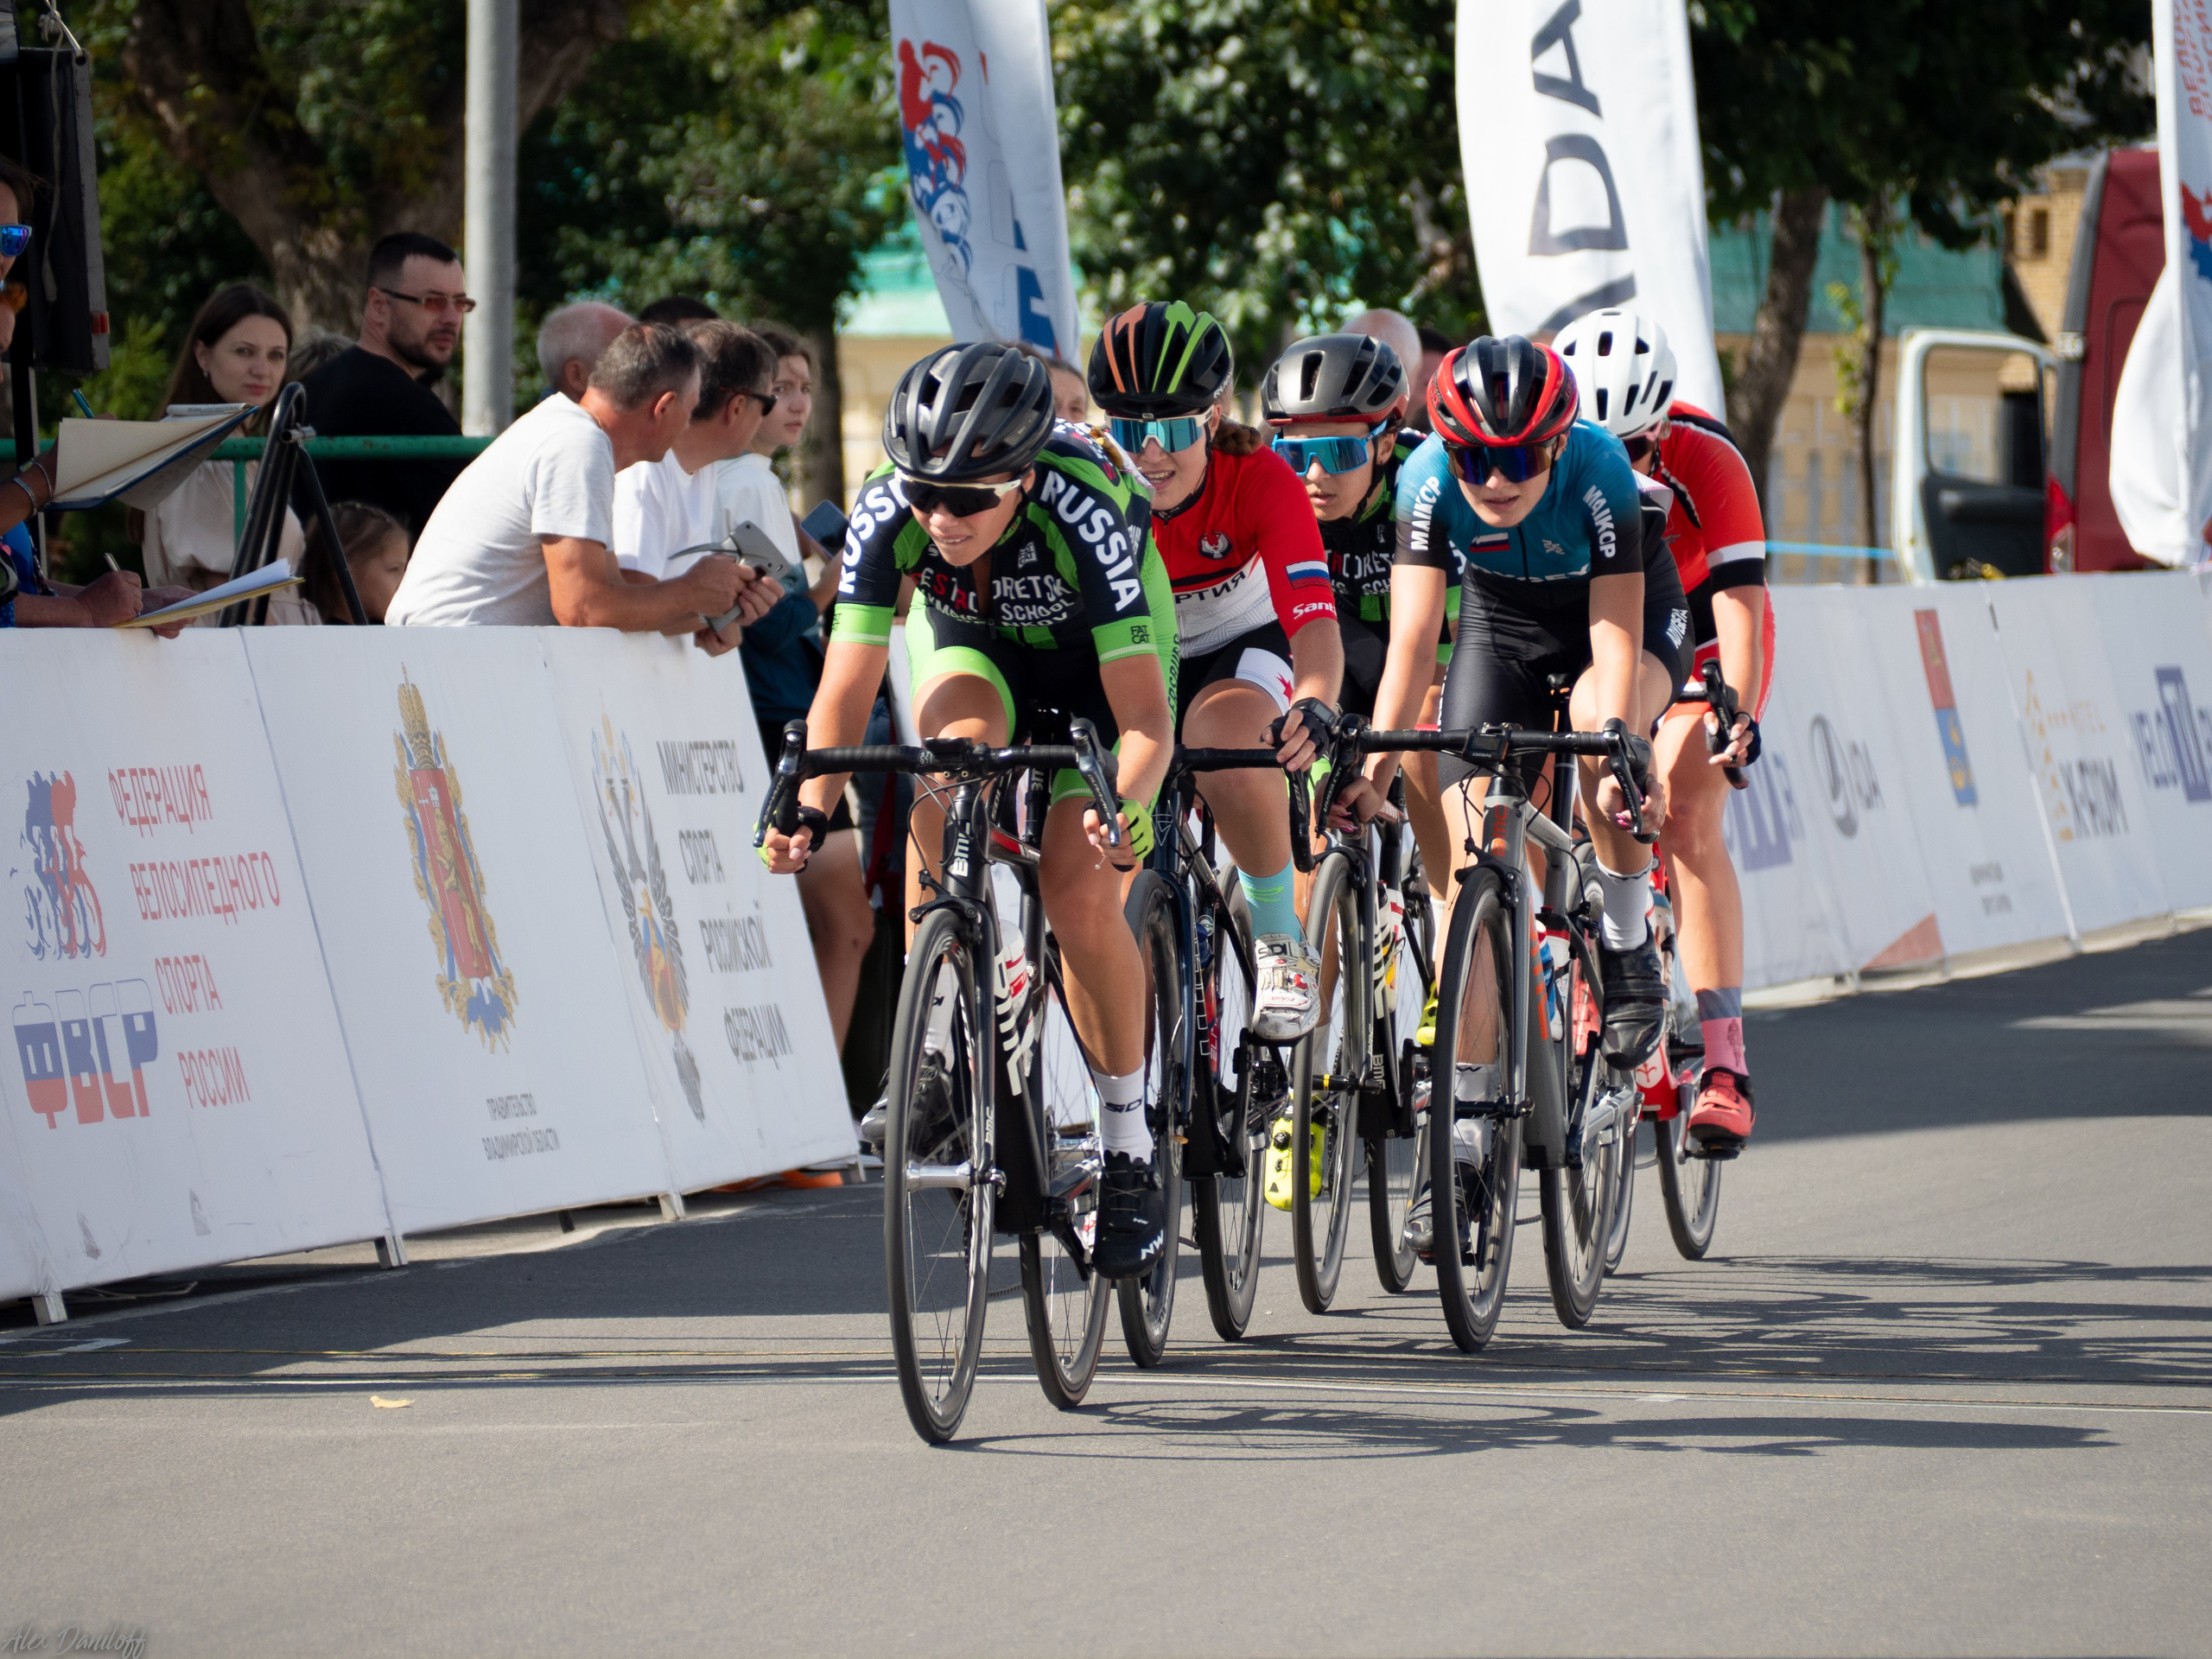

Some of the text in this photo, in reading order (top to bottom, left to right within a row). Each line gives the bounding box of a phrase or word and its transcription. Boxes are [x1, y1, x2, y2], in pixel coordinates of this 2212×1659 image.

[1040, 470, 1141, 612] RUSSIA
[1410, 476, 1441, 550] MAIKOP
[1582, 485, 1617, 558] MAIKOP
[1001, 599, 1075, 620] SCHOOL
[1130, 626, 1147, 636] FAT
[1131, 634, 1150, 645] CAT
[656, 740, 744, 795] МИНИСТЕРСТВО
[108, 764, 213, 837] ФЕДЕРАЦИЯ
[130, 850, 281, 925] ВЕЛОСИПЕДНОГО
[678, 829, 726, 885] СПОРТА
[697, 899, 773, 974] РОССИЙСКОЙ
[155, 954, 223, 1015] СПОРТА
[723, 1003, 793, 1073] ФЕДЕРАЦИИ
[177, 1046, 251, 1109] РОССИИ
[1141, 1229, 1164, 1261] NW
